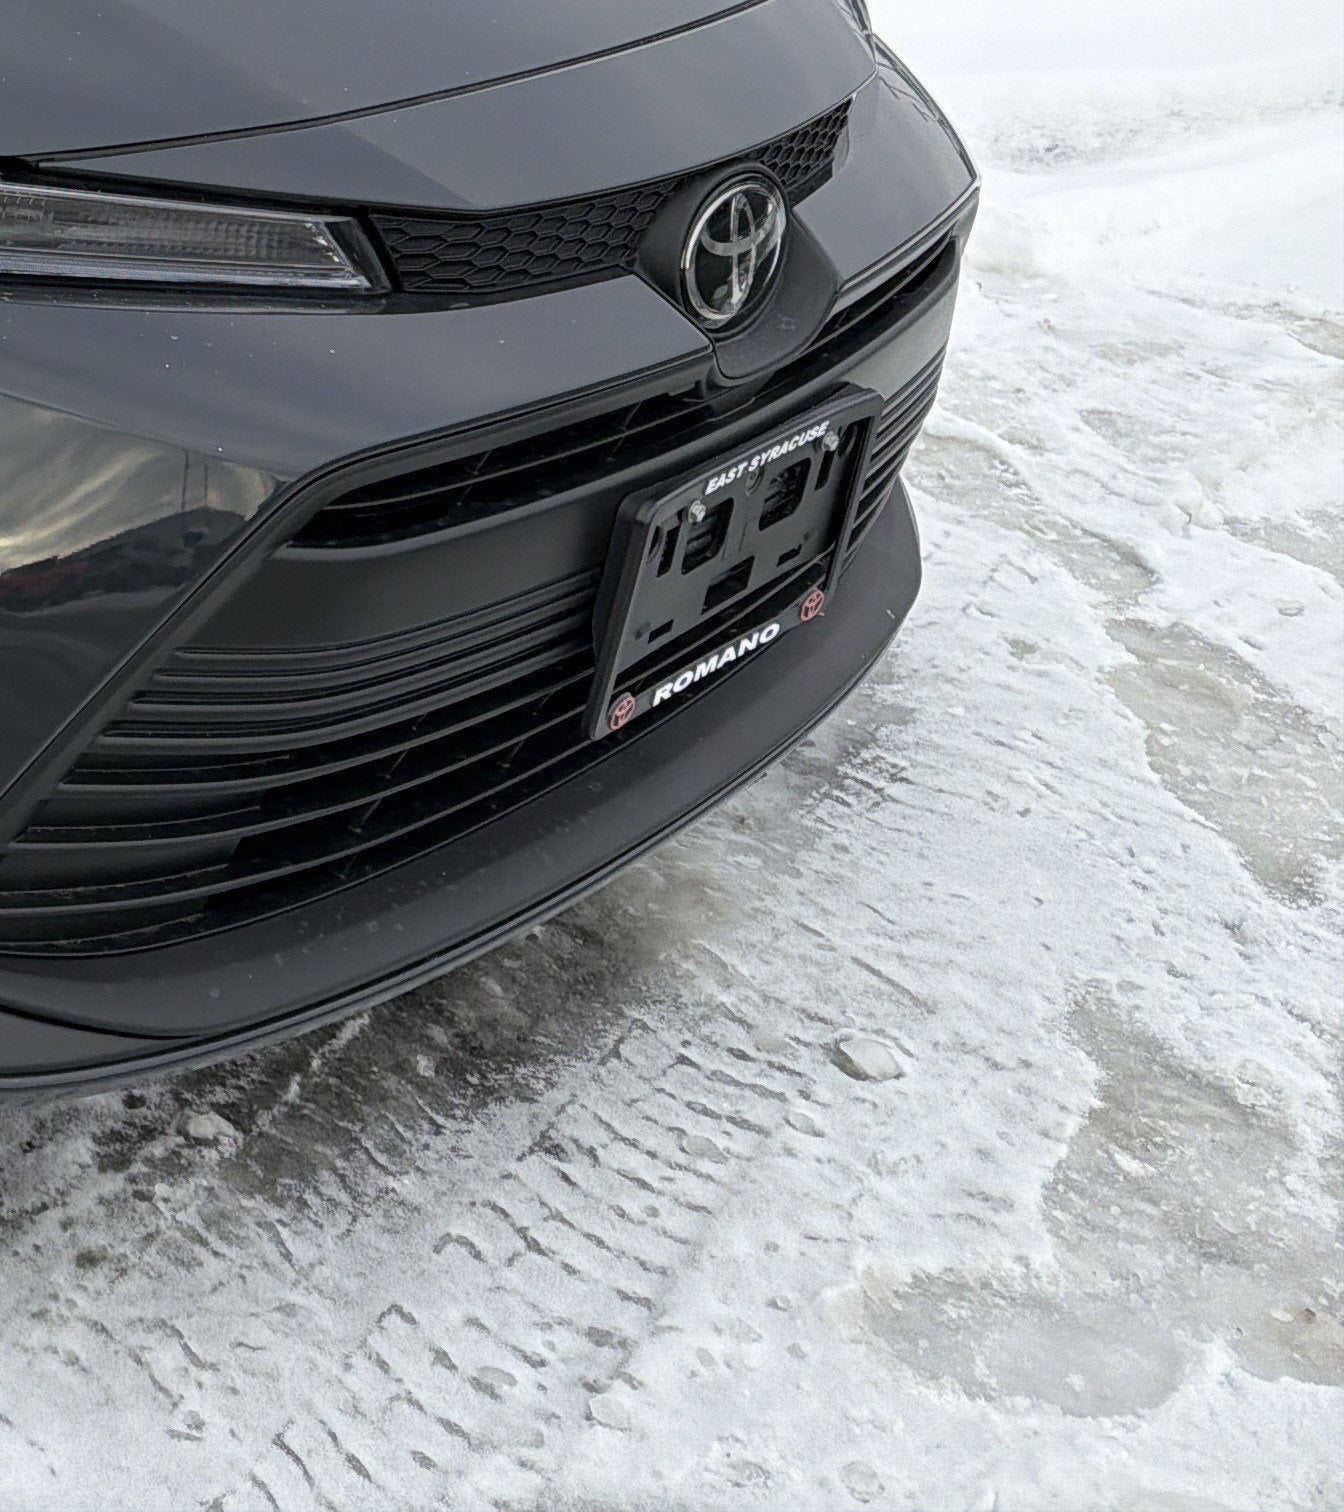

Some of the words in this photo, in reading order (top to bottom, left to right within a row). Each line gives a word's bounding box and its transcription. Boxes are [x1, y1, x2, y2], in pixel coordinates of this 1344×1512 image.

[705, 460, 749, 496] EAST
[748, 419, 831, 472] SYRACUSE
[652, 622, 781, 708] ROMANO
